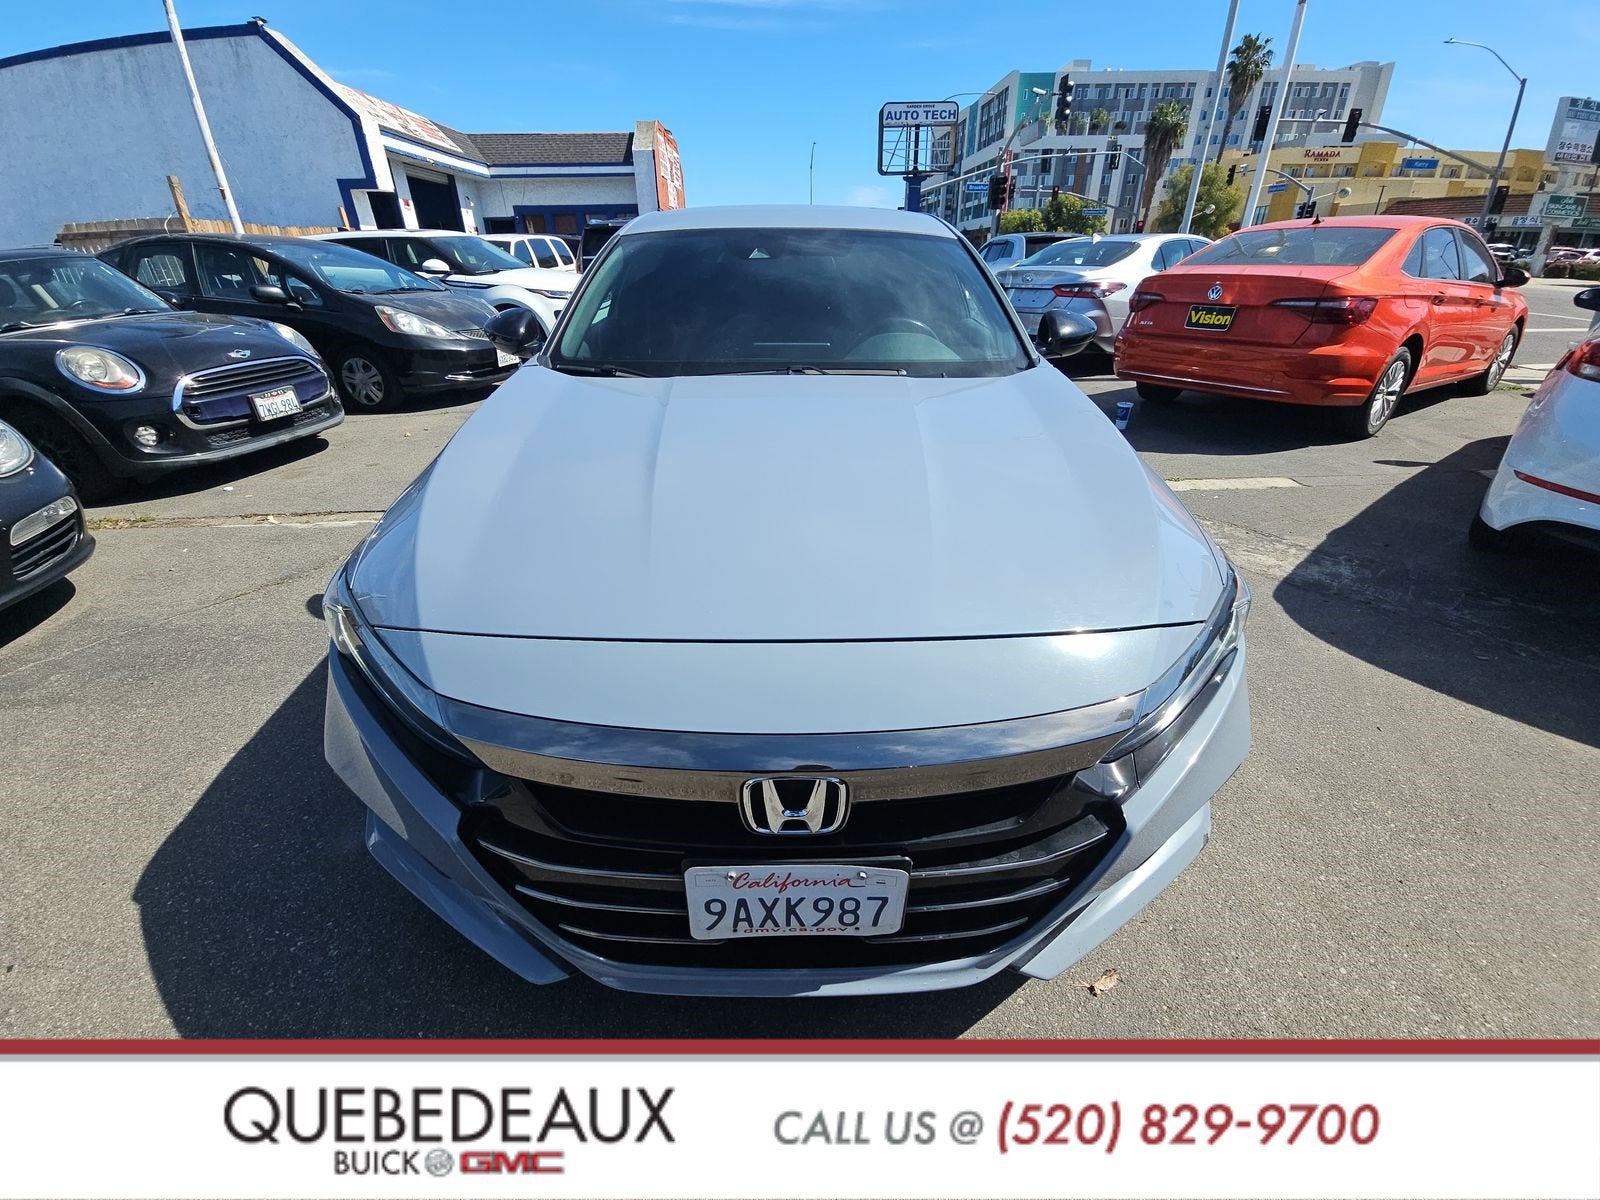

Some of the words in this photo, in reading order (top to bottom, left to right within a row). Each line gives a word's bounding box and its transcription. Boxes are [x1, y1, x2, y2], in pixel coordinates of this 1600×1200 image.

[885, 110, 919, 121] AUTO
[923, 109, 957, 120] TECH
[1304, 149, 1341, 158] RAMADA
[1190, 310, 1231, 325] Vision
[732, 872, 866, 894] California
[704, 896, 889, 931] 9AXK987
[743, 926, 848, 935] dmv.ca.gov
